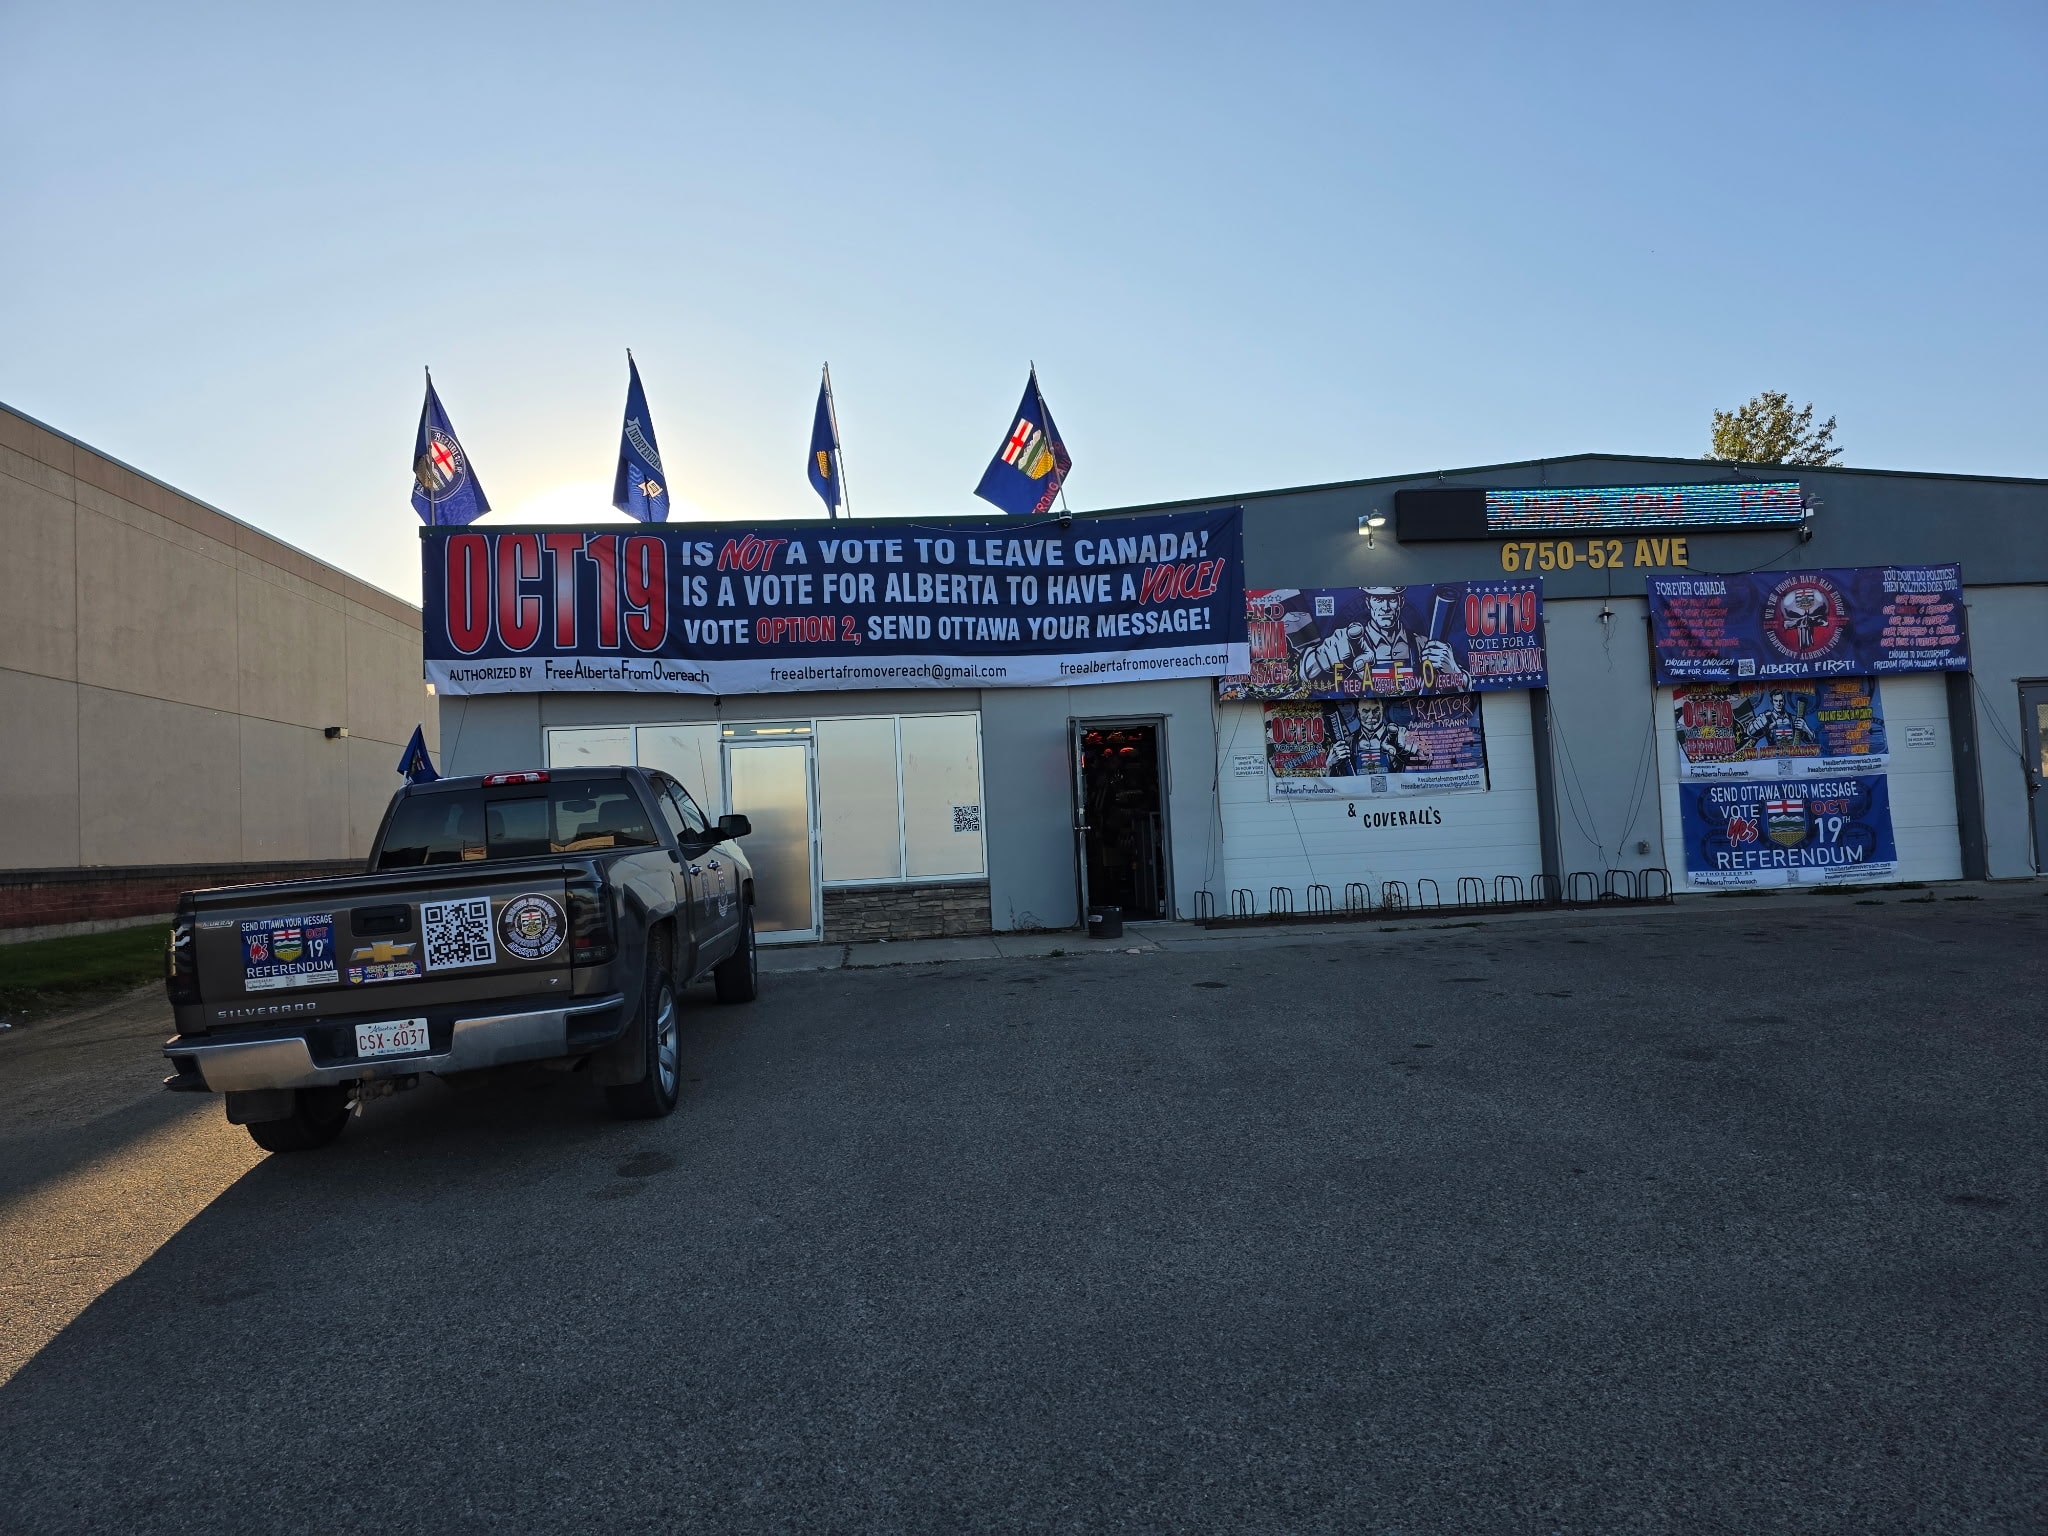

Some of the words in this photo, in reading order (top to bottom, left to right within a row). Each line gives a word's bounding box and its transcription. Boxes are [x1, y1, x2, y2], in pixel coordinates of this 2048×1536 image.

[434, 432, 462, 465] REPUBLIC
[682, 540, 713, 566] IS
[717, 533, 788, 572] NOT
[787, 540, 806, 566] A
[818, 538, 903, 565] VOTE
[914, 538, 956, 564] TO
[968, 538, 1064, 567] LEAVE
[1074, 530, 1209, 567] CANADA!
[1501, 539, 1624, 571] 6750-52
[1633, 538, 1688, 568] AVE
[682, 574, 711, 607] IS
[717, 574, 736, 607] A
[744, 573, 813, 606] VOTE
[823, 572, 876, 604] FOR
[884, 572, 999, 606] ALBERTA
[1006, 574, 1038, 606] TO
[1047, 574, 1112, 605] HAVE
[1119, 573, 1137, 601] A
[1138, 556, 1226, 606] VOICE!
[1800, 575, 1817, 584] HAVE
[1819, 578, 1832, 591] HAD
[1883, 570, 1896, 581] YOU
[1916, 570, 1925, 581] DO
[1655, 582, 1692, 595] FOREVER
[1693, 581, 1726, 595] CANADA
[1775, 576, 1797, 594] PEOPLE
[1883, 582, 1898, 592] THEN
[1899, 581, 1927, 592] POLITICS
[1927, 581, 1942, 592] DOES
[1768, 592, 1778, 606] THE
[1830, 591, 1845, 616] ENOUGH
[1764, 608, 1775, 619] WE
[683, 619, 750, 645] VOTE
[756, 616, 835, 645] OPTION
[841, 616, 862, 645] 2,
[867, 614, 931, 641] SEND
[938, 616, 1021, 641] OTTAWA
[1027, 615, 1090, 640] YOUR
[1096, 607, 1211, 638] MESSAGE!
[1468, 639, 1498, 649] VOTE
[1501, 637, 1524, 649] FOR
[1527, 635, 1536, 646] A
[1800, 646, 1830, 660] ALBERTA
[1828, 626, 1844, 648] STRONG
[449, 667, 516, 682] AUTHORIZED
[519, 666, 532, 680] BY
[545, 660, 710, 683] FreeAlbertaFromOvereach
[771, 664, 1007, 681] freealbertafromovereach@gmail.com
[1060, 652, 1229, 676] freealbertafromovereach.com
[1468, 646, 1543, 676] REFERENDUM
[1664, 658, 1692, 667] ENOUGH
[1702, 657, 1734, 667] ENOUGH
[1759, 662, 1809, 675] ALBERTA
[1814, 660, 1855, 672] FIRST!
[1703, 667, 1730, 675] CHANGE
[1402, 694, 1473, 720] TRAITOR
[1435, 717, 1469, 728] TYRANNY
[1711, 786, 1738, 802] SEND
[1741, 785, 1780, 801] OTTAWA
[1781, 783, 1808, 799] YOUR
[1810, 781, 1858, 798] MESSAGE
[1348, 803, 1356, 817] &
[1364, 806, 1441, 828] COVERALL'S
[1720, 804, 1760, 818] VOTE
[1811, 799, 1850, 815] OCT
[1716, 845, 1863, 869] REFERENDUM
[241, 921, 259, 931] SEND
[260, 919, 284, 930] OTTAWA
[285, 918, 302, 928] YOUR
[303, 914, 333, 926] MESSAGE
[246, 933, 269, 944] VOTE
[305, 927, 328, 939] OCT
[246, 960, 333, 978] REFERENDUM
[217, 1002, 316, 1018] SILVERADO
[360, 1029, 425, 1050] CSX-6037
